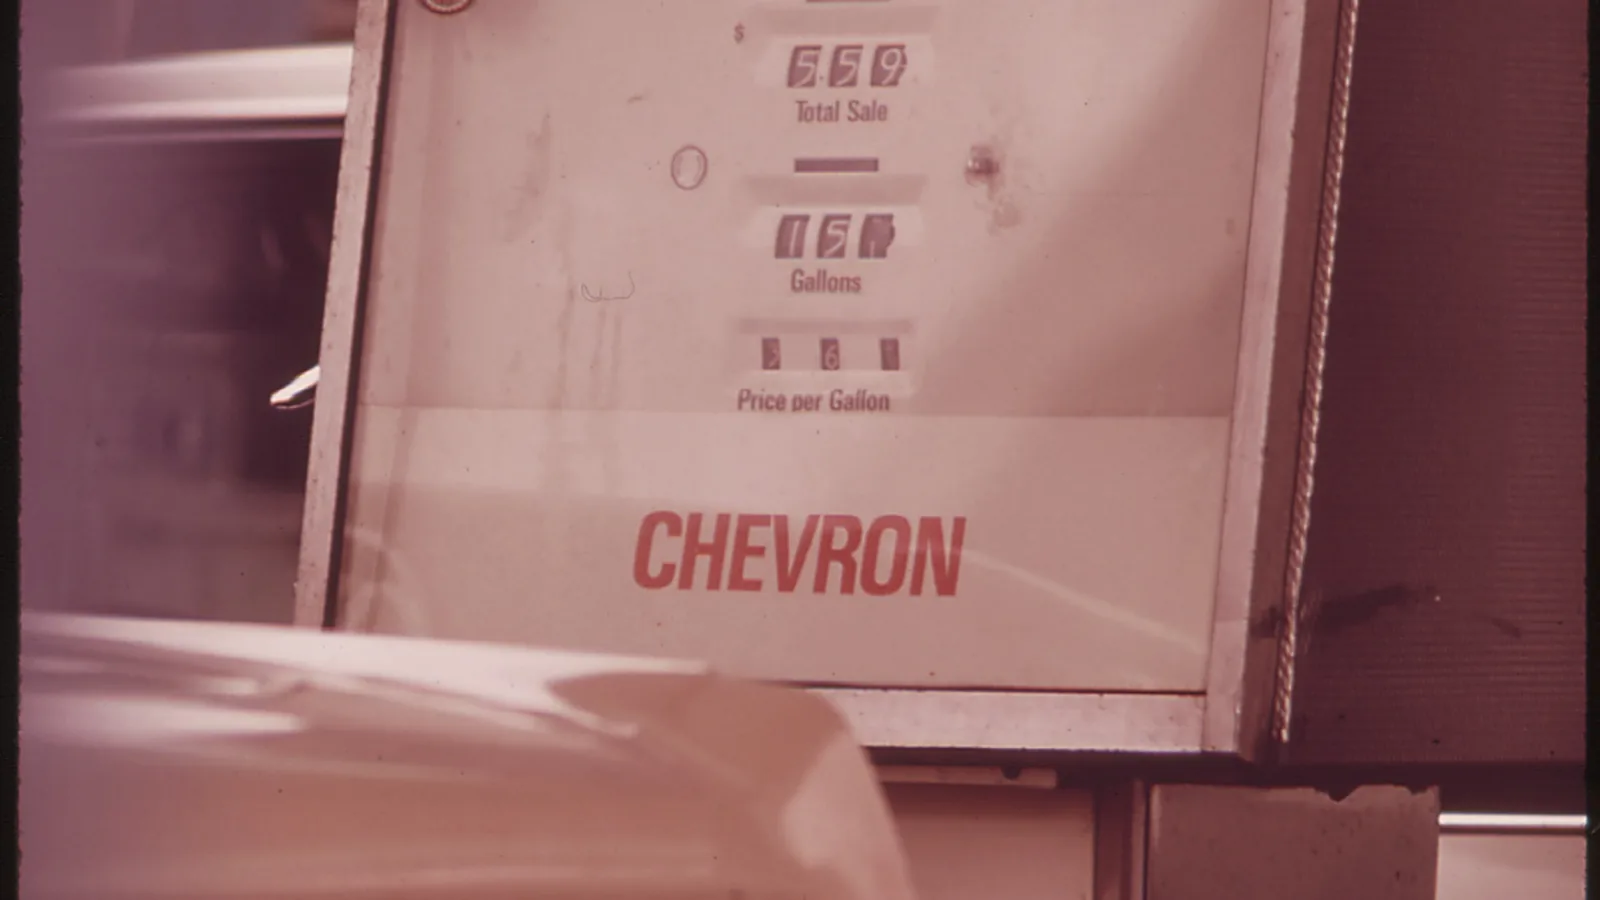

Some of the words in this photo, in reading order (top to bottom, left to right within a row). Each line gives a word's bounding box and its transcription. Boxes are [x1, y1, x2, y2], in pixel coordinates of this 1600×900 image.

[733, 21, 746, 44] $
[796, 100, 840, 122] Total
[847, 100, 888, 122] Sale
[790, 268, 862, 293] Gallons
[737, 388, 786, 411] Price
[791, 394, 822, 411] per
[829, 388, 890, 411] Gallon
[633, 510, 966, 597] CHEVRON
